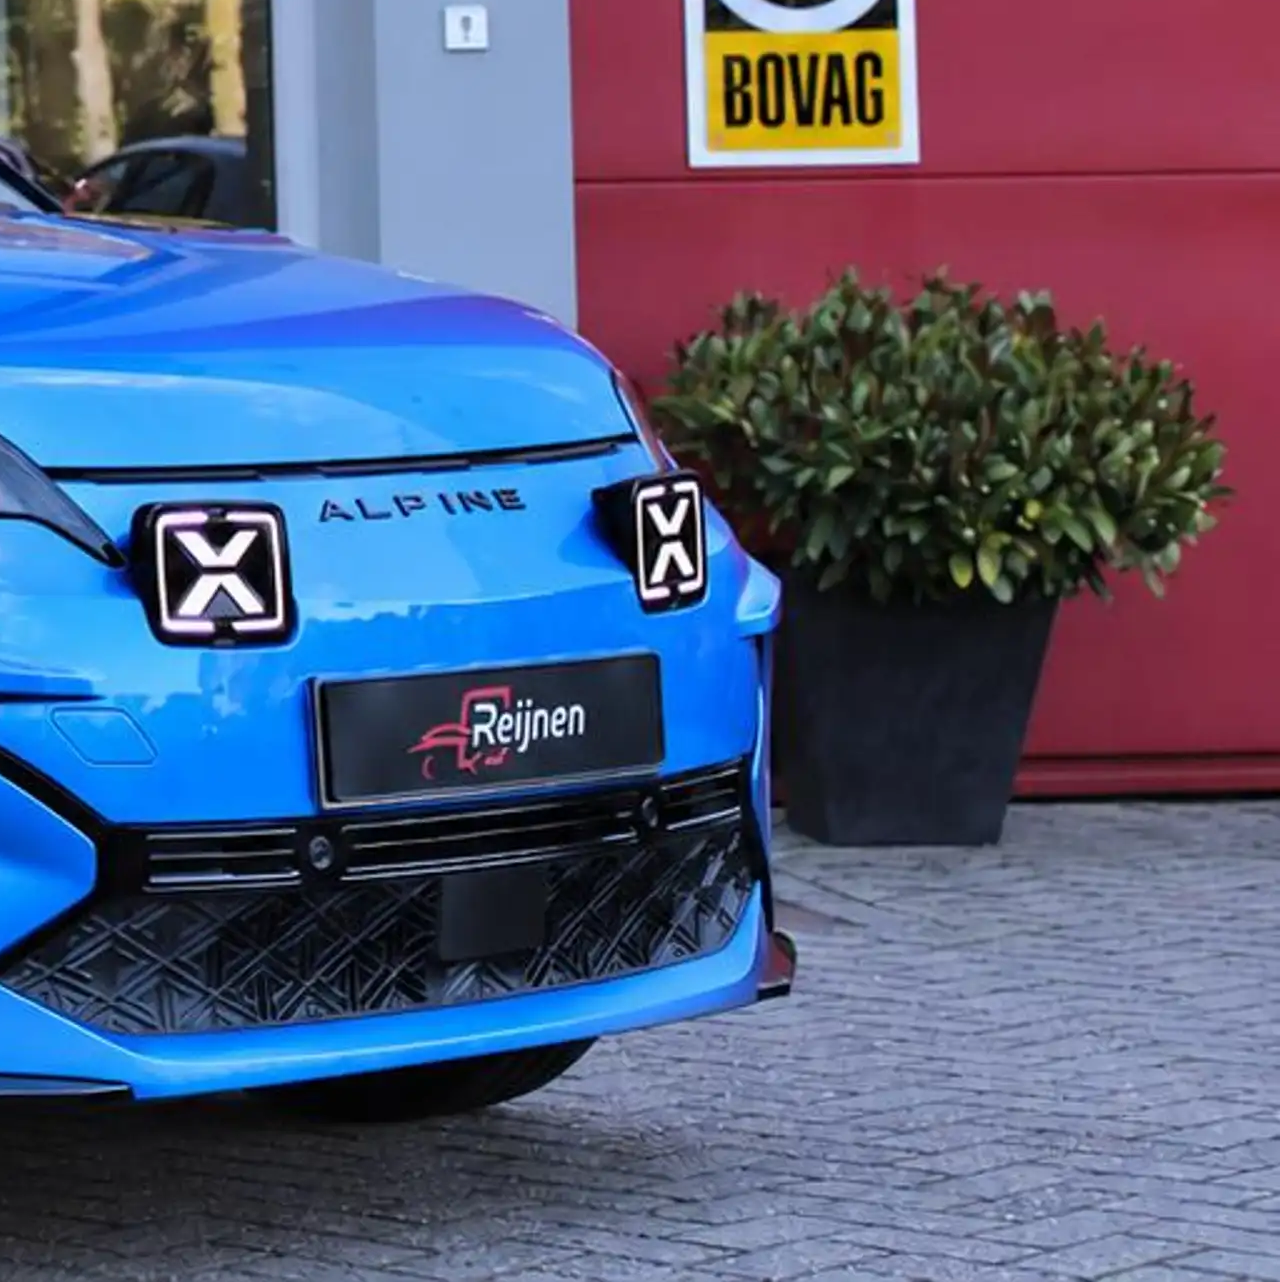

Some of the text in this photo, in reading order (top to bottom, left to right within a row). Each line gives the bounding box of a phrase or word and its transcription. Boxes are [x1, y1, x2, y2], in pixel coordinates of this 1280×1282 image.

[723, 51, 884, 130] BOVAG
[319, 488, 526, 522] ALPINE
[472, 698, 585, 753] Reijnen
